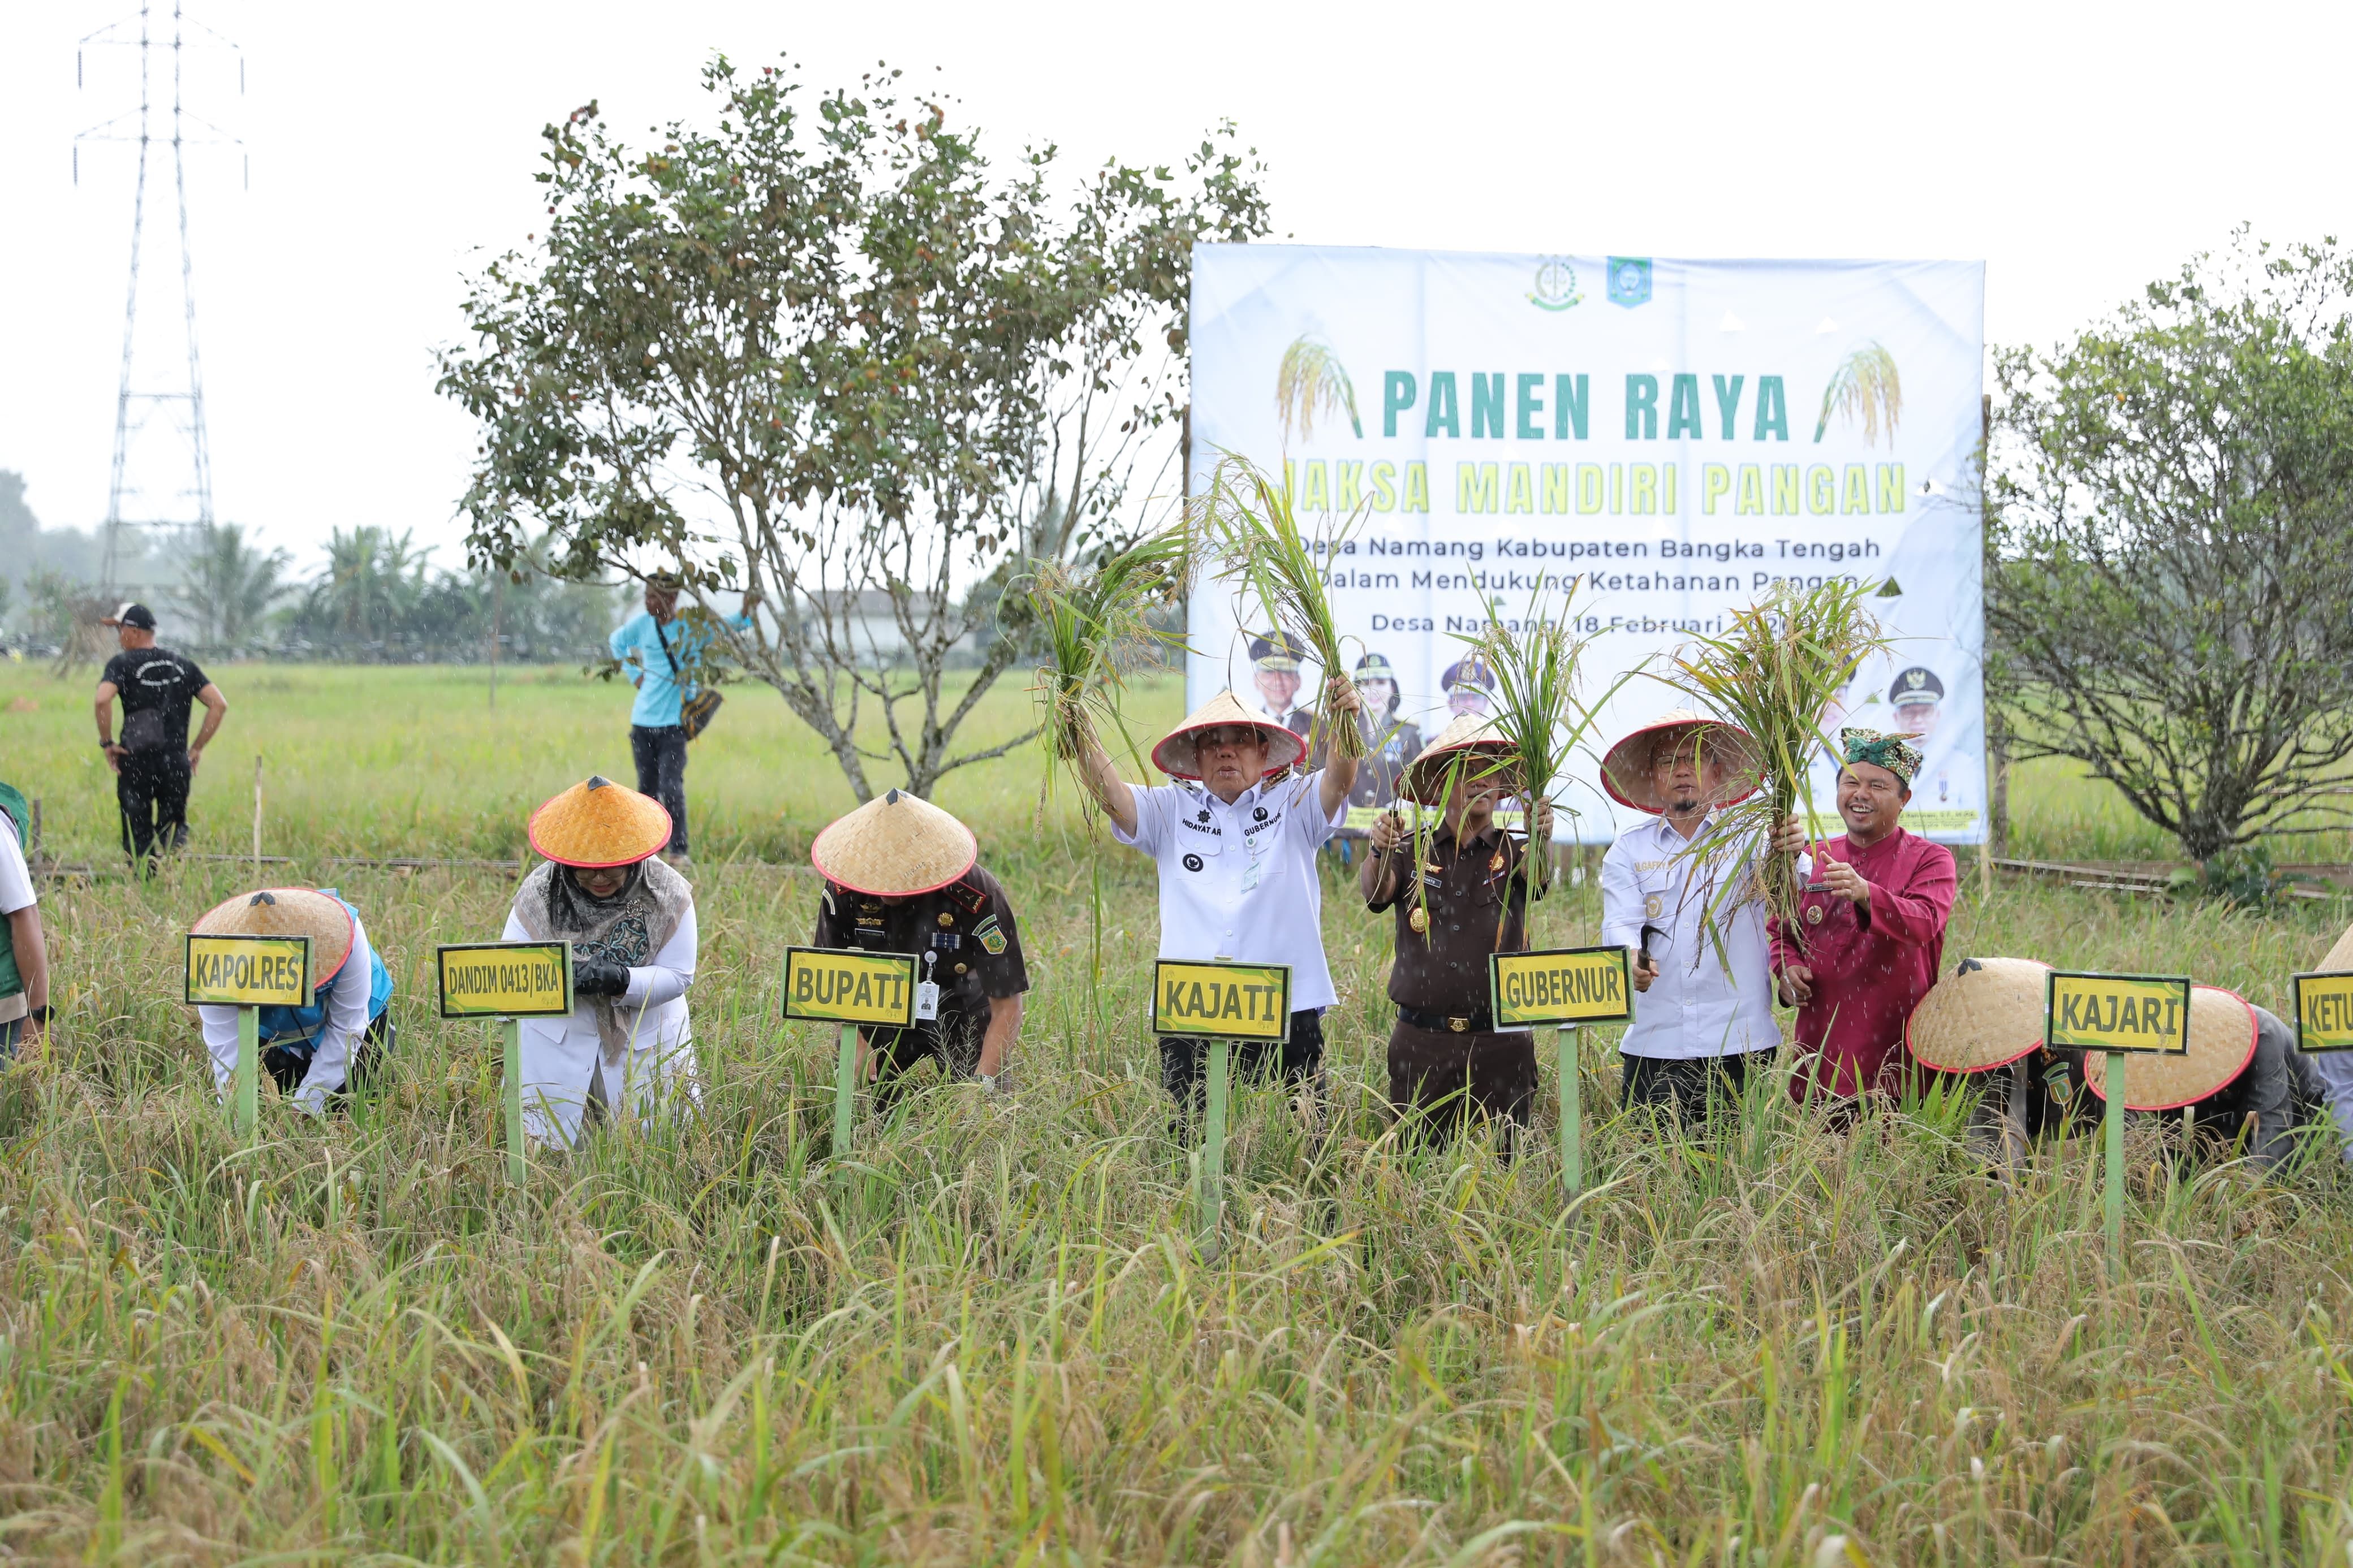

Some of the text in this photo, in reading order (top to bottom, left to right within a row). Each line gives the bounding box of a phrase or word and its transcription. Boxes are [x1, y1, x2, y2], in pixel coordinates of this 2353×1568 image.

[1384, 371, 1789, 441] PANEN RAYA
[1269, 458, 1906, 515] JAKSA MANDIRI PANGAN
[1298, 537, 1880, 561] Desa Namang Kabupaten Bangka Tengah
[1412, 570, 1575, 594] Mendukung
[1590, 572, 1739, 591] Ketahanan
[1372, 614, 1433, 632] Desa
[1573, 616, 1598, 633] 18
[1610, 616, 1722, 634] Februari
[1182, 818, 1222, 836] HIDAYAT AR
[1244, 813, 1282, 837] GUBERNUR
[196, 953, 299, 991] KAPOLRES
[449, 962, 559, 998] DANDIM 0413/BKA
[796, 967, 905, 1009] BUPATI
[1506, 966, 1621, 1008] GUBERNUR
[1166, 980, 1276, 1021] KAJATI
[2061, 993, 2178, 1035] KAJARI
[2307, 992, 2353, 1032] KETU
